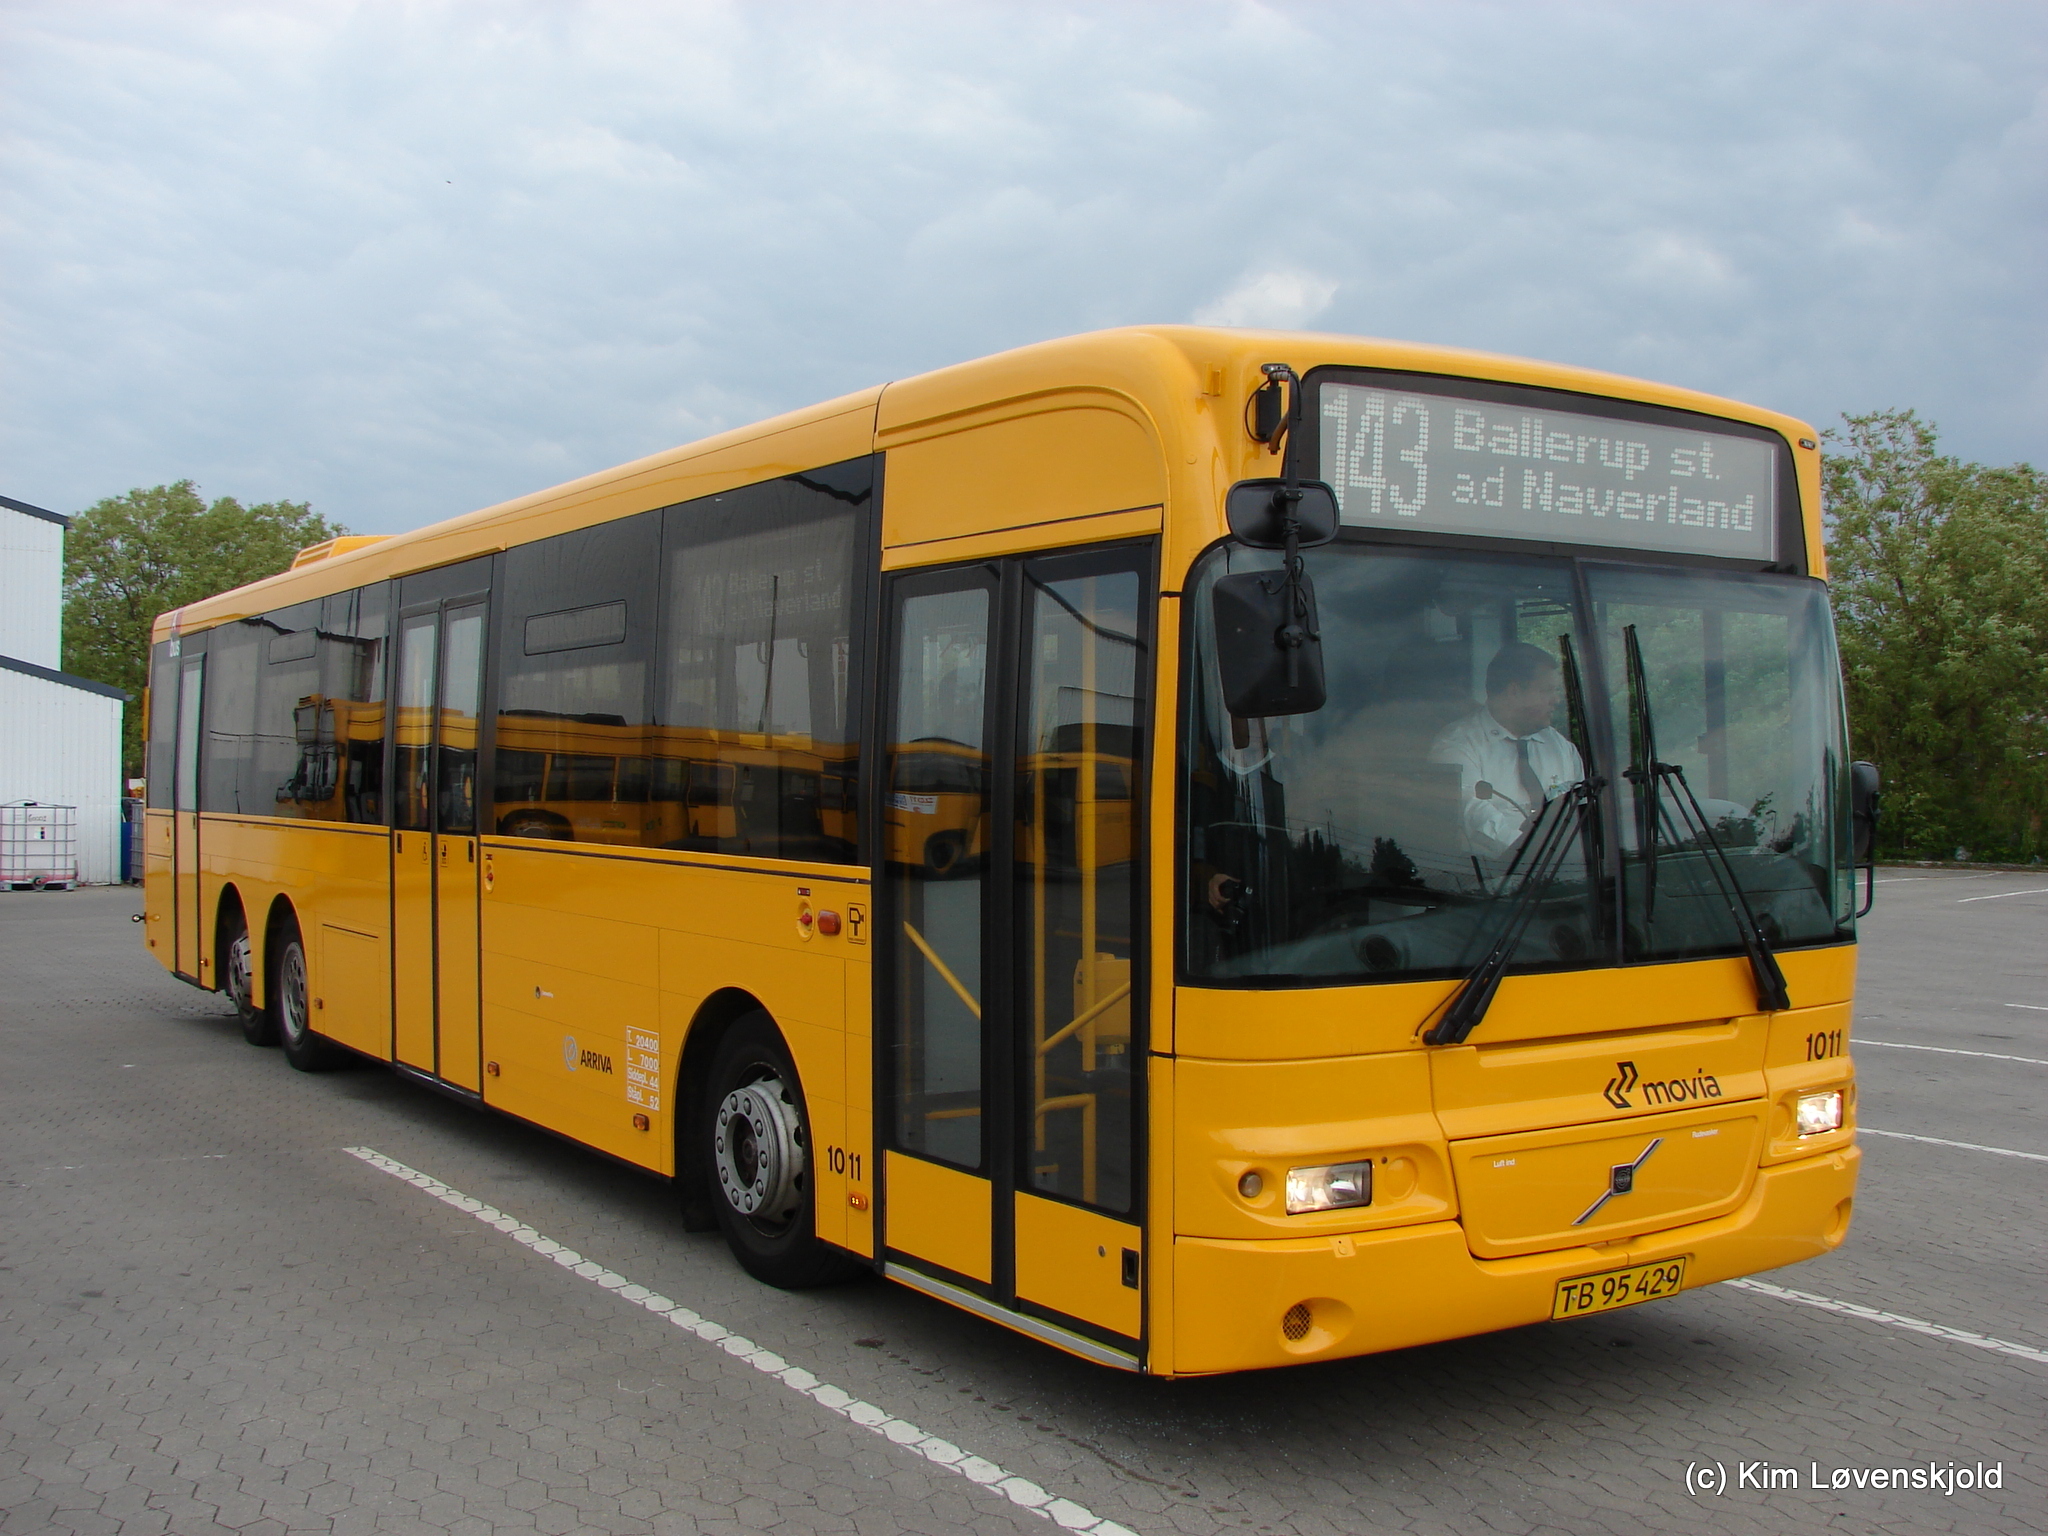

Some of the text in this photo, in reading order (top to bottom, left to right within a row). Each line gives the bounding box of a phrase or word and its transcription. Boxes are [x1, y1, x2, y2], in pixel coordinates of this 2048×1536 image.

[1323, 388, 1429, 516] 143
[1454, 408, 1720, 481] Ballerup st.
[1522, 469, 1754, 531] Naverland
[635, 1034, 658, 1052] 20400
[1806, 1028, 1842, 1062] 1011
[580, 1049, 613, 1075] ARRIVA
[639, 1053, 659, 1071] 7000
[649, 1075, 659, 1090] 44
[649, 1094, 660, 1109] 52
[827, 1145, 861, 1182] 1011
[1561, 1264, 1680, 1313] TB 95 429
